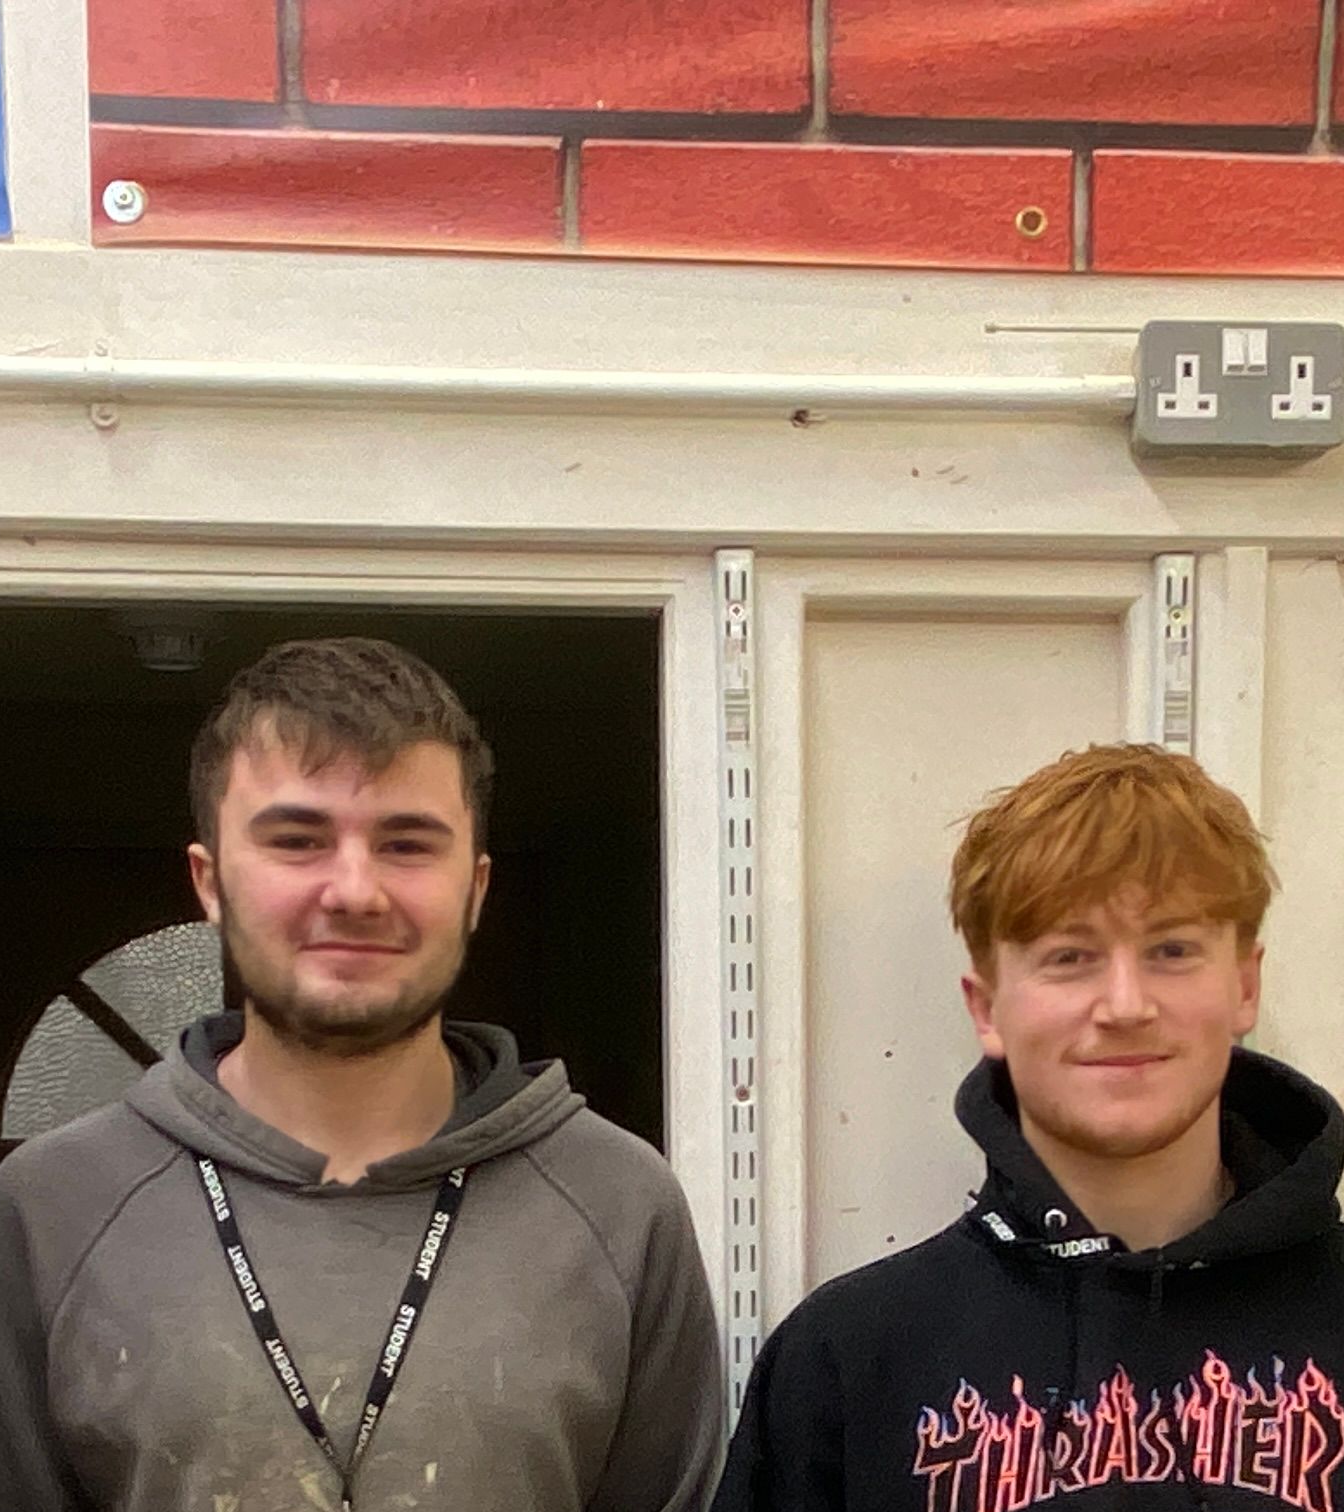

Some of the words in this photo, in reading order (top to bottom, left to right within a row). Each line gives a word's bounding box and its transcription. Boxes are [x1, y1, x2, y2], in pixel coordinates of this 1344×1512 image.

[227, 1245, 266, 1313] STUDENT
[416, 1211, 450, 1281] STUDENT
[1048, 1236, 1111, 1259] TUDENT
[265, 1337, 309, 1410] STUDENT
[381, 1304, 417, 1378] STUDENT
[357, 1403, 379, 1454] STUD
